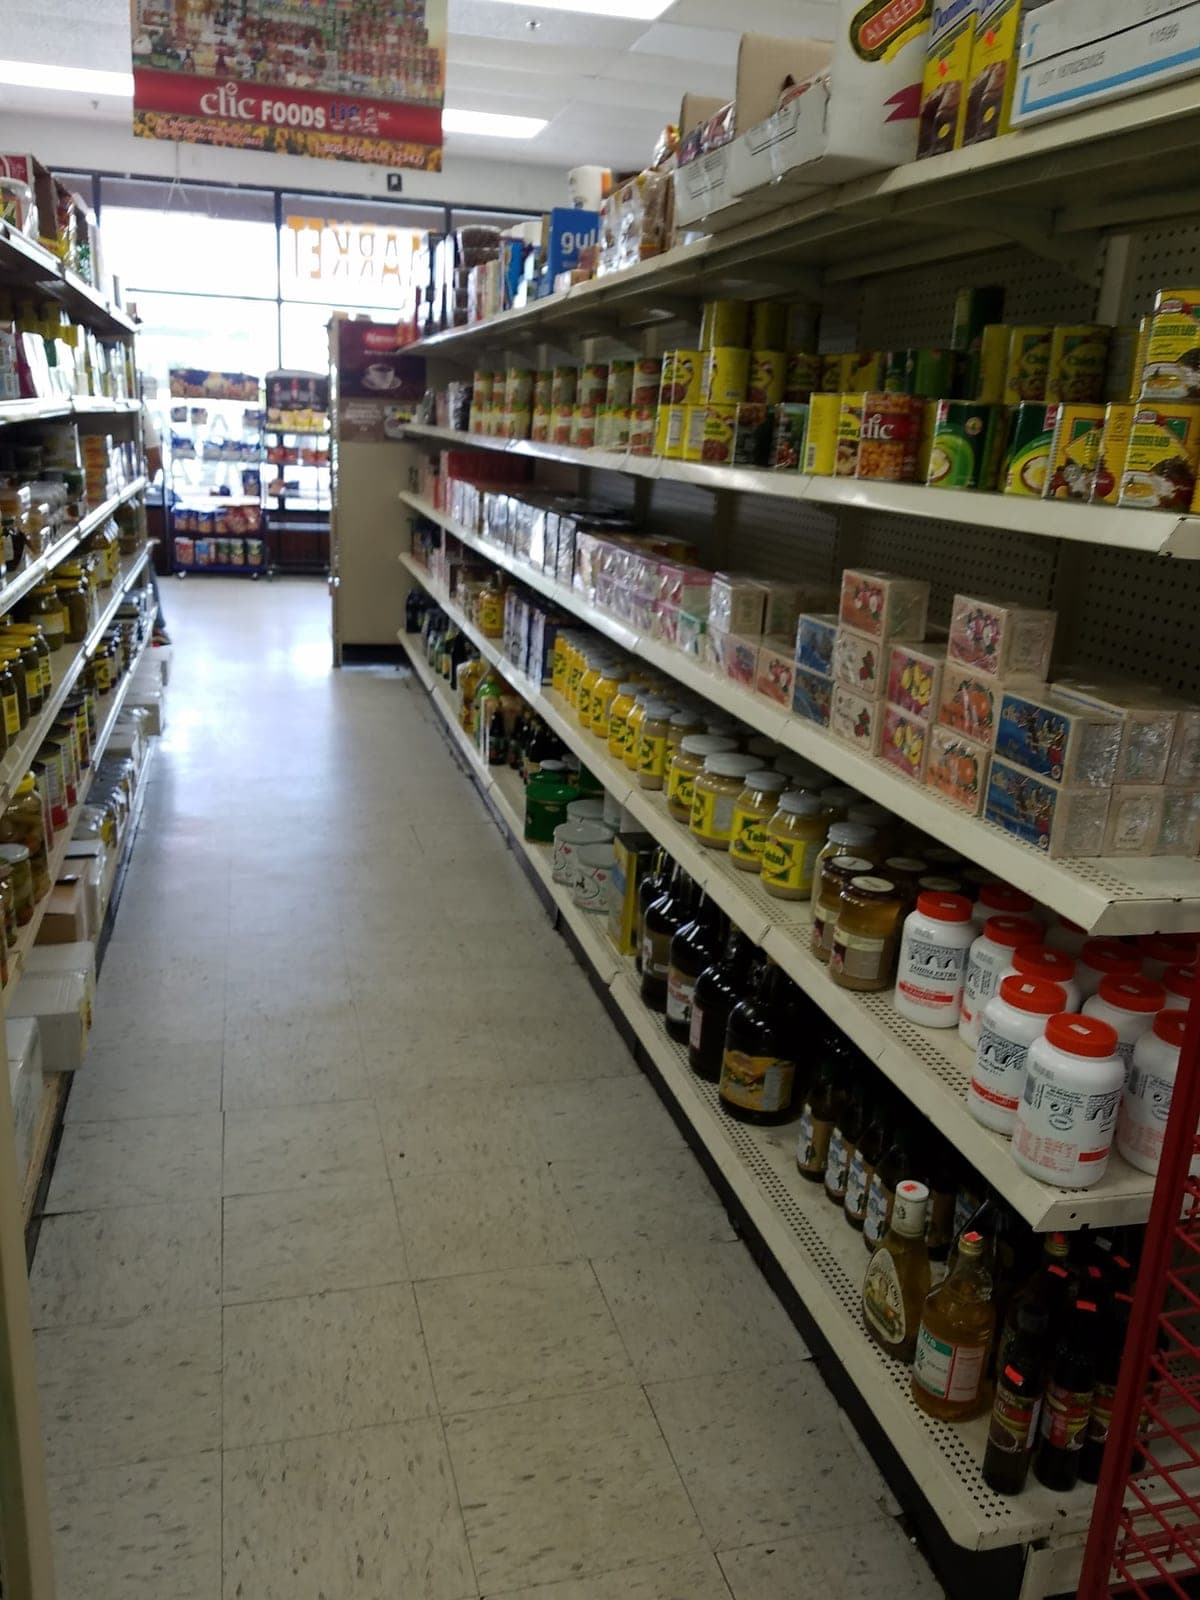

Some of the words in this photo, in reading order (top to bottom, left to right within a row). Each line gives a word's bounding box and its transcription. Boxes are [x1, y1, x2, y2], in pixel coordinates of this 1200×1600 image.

[200, 82, 257, 119] clic
[261, 100, 326, 128] FOODS
[329, 103, 379, 133] USA
